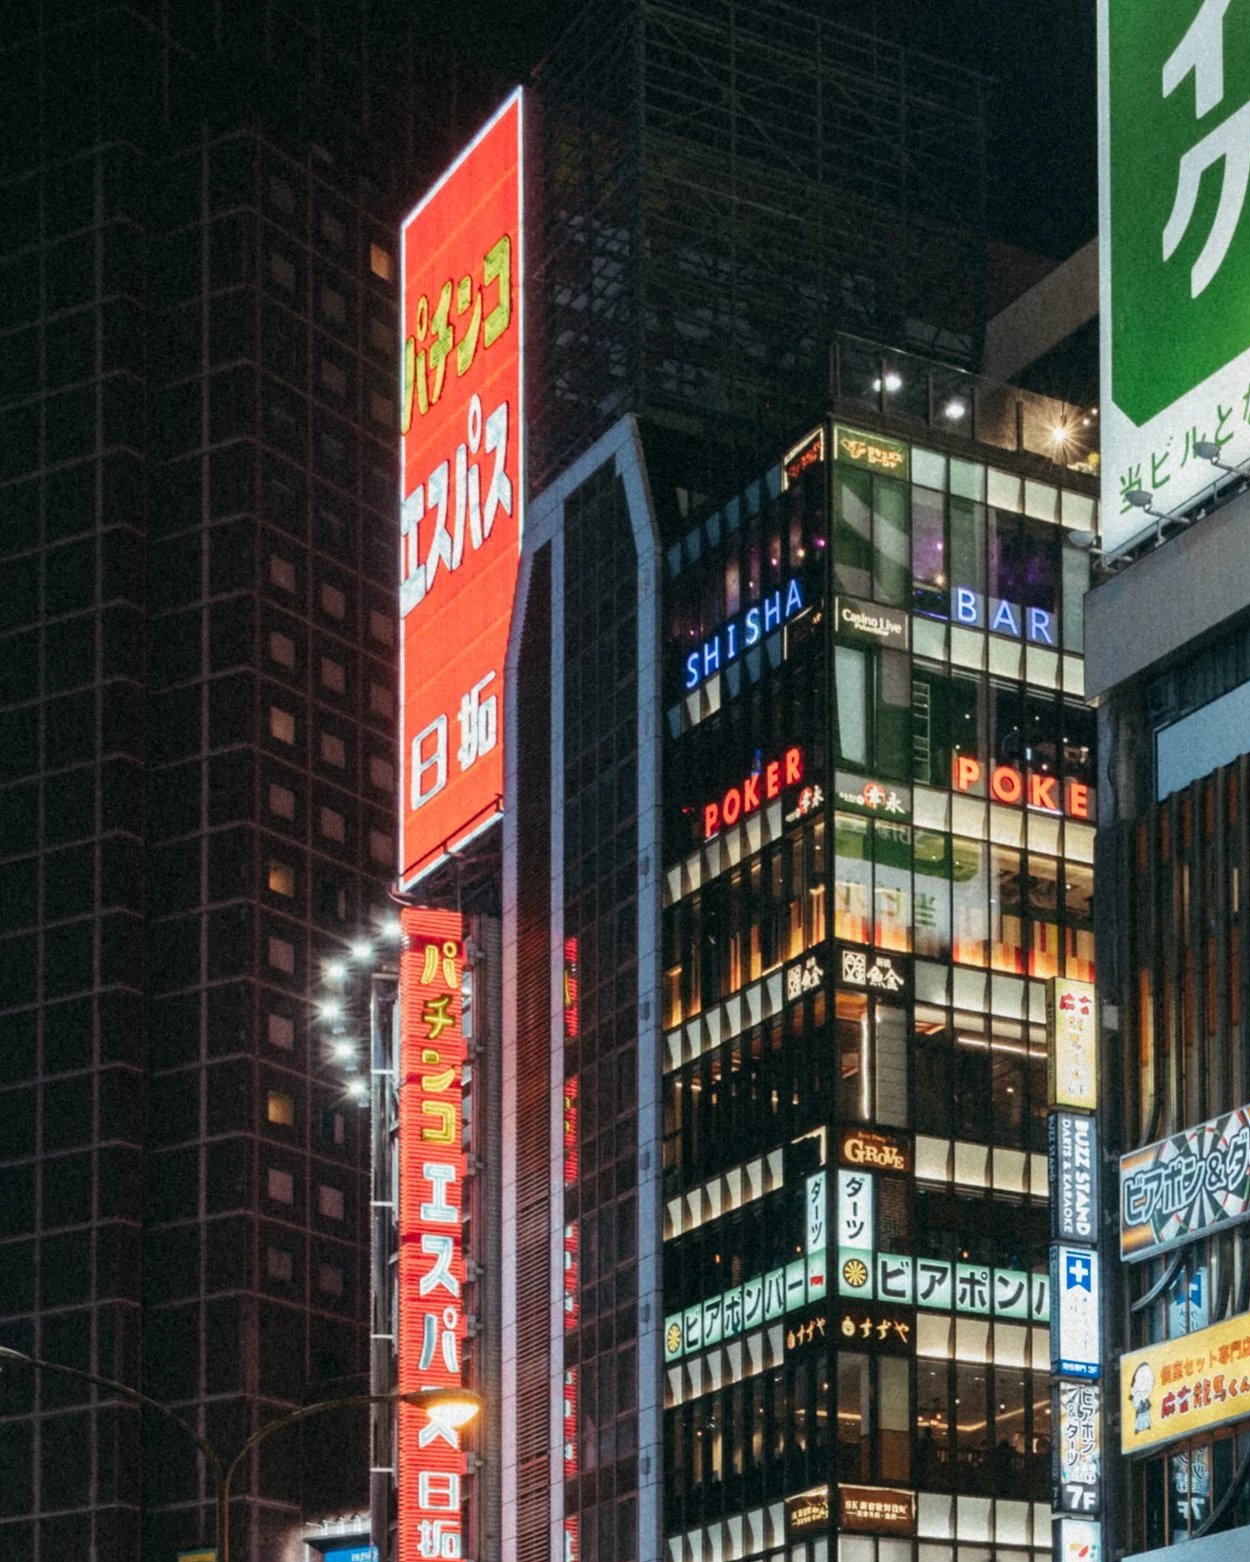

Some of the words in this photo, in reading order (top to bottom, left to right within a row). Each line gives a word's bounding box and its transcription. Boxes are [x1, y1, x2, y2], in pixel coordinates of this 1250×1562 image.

[401, 235, 512, 435] パチンコ
[401, 393, 512, 618] エスパス
[686, 578, 802, 690] SHISHA
[957, 586, 1053, 645] BAR
[411, 669, 498, 812] 日拓
[704, 744, 804, 845] POKER
[954, 753, 1090, 819] POKE
[420, 941, 460, 1145] パチンコ
[810, 1177, 823, 1245] ダーツ
[845, 1176, 866, 1240] ダーツ
[1063, 1174, 1073, 1234] KARAOKE
[1076, 1170, 1092, 1236] STAND
[684, 1266, 803, 1354] ビアポンバー
[416, 1470, 462, 1559] 日拓
[1065, 1485, 1096, 1511] 7F
